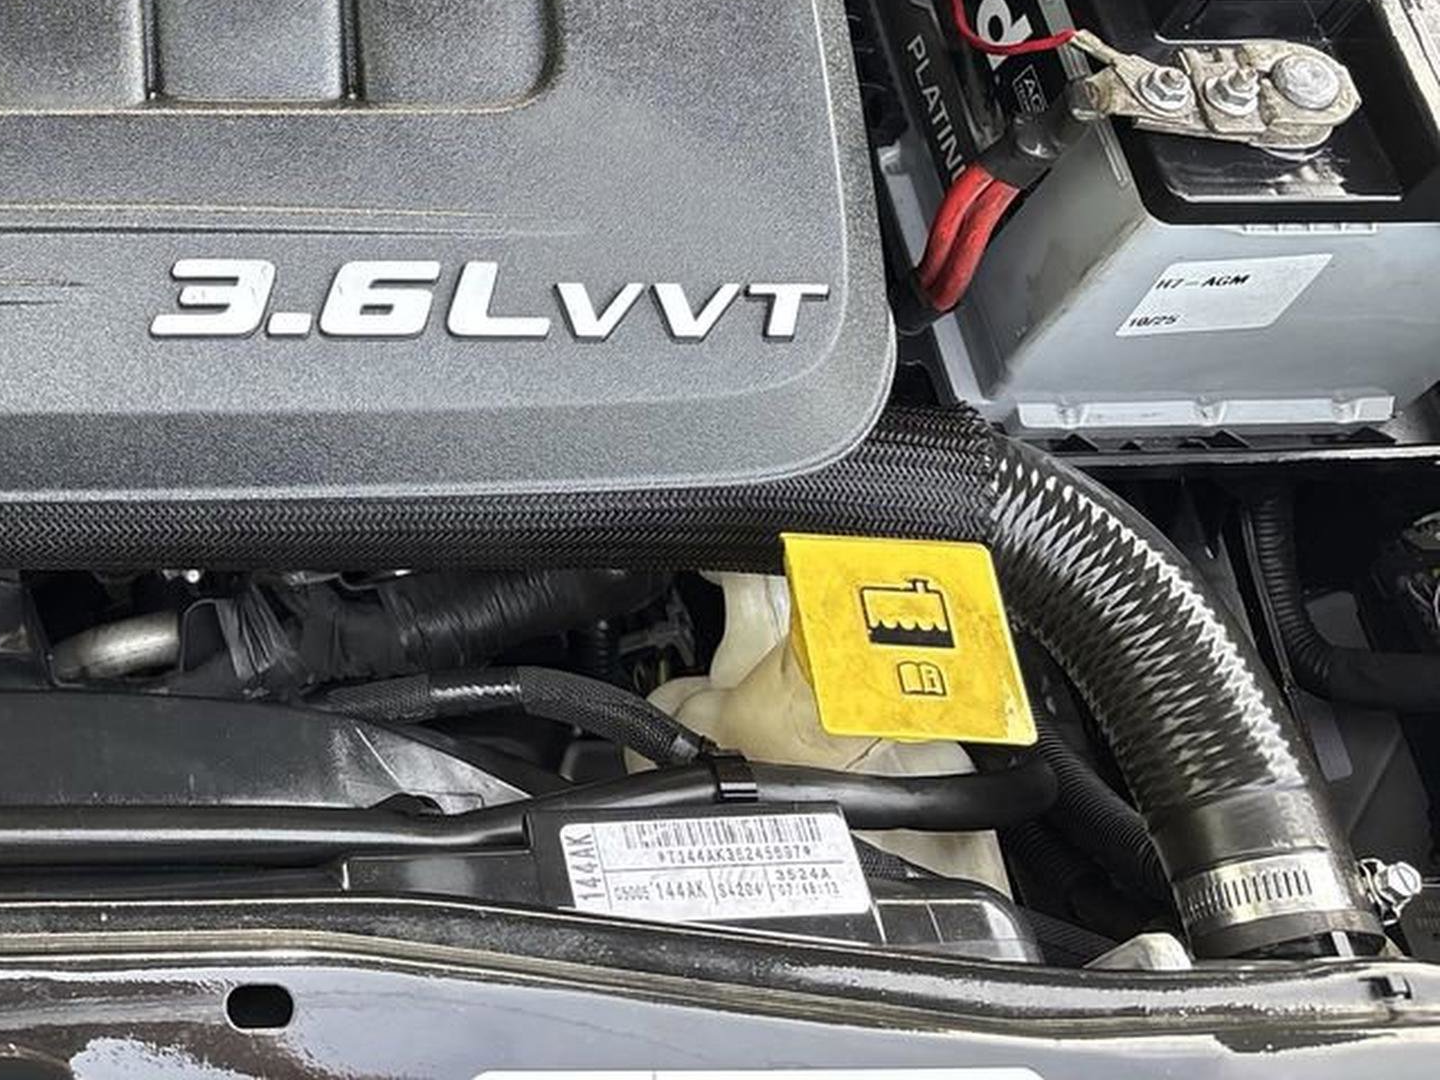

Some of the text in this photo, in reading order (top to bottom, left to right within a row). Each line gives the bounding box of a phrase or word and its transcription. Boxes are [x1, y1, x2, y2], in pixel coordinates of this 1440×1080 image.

[556, 281, 831, 343] VVT
[1127, 314, 1180, 329] 10/25
[563, 832, 606, 903] 144AK
